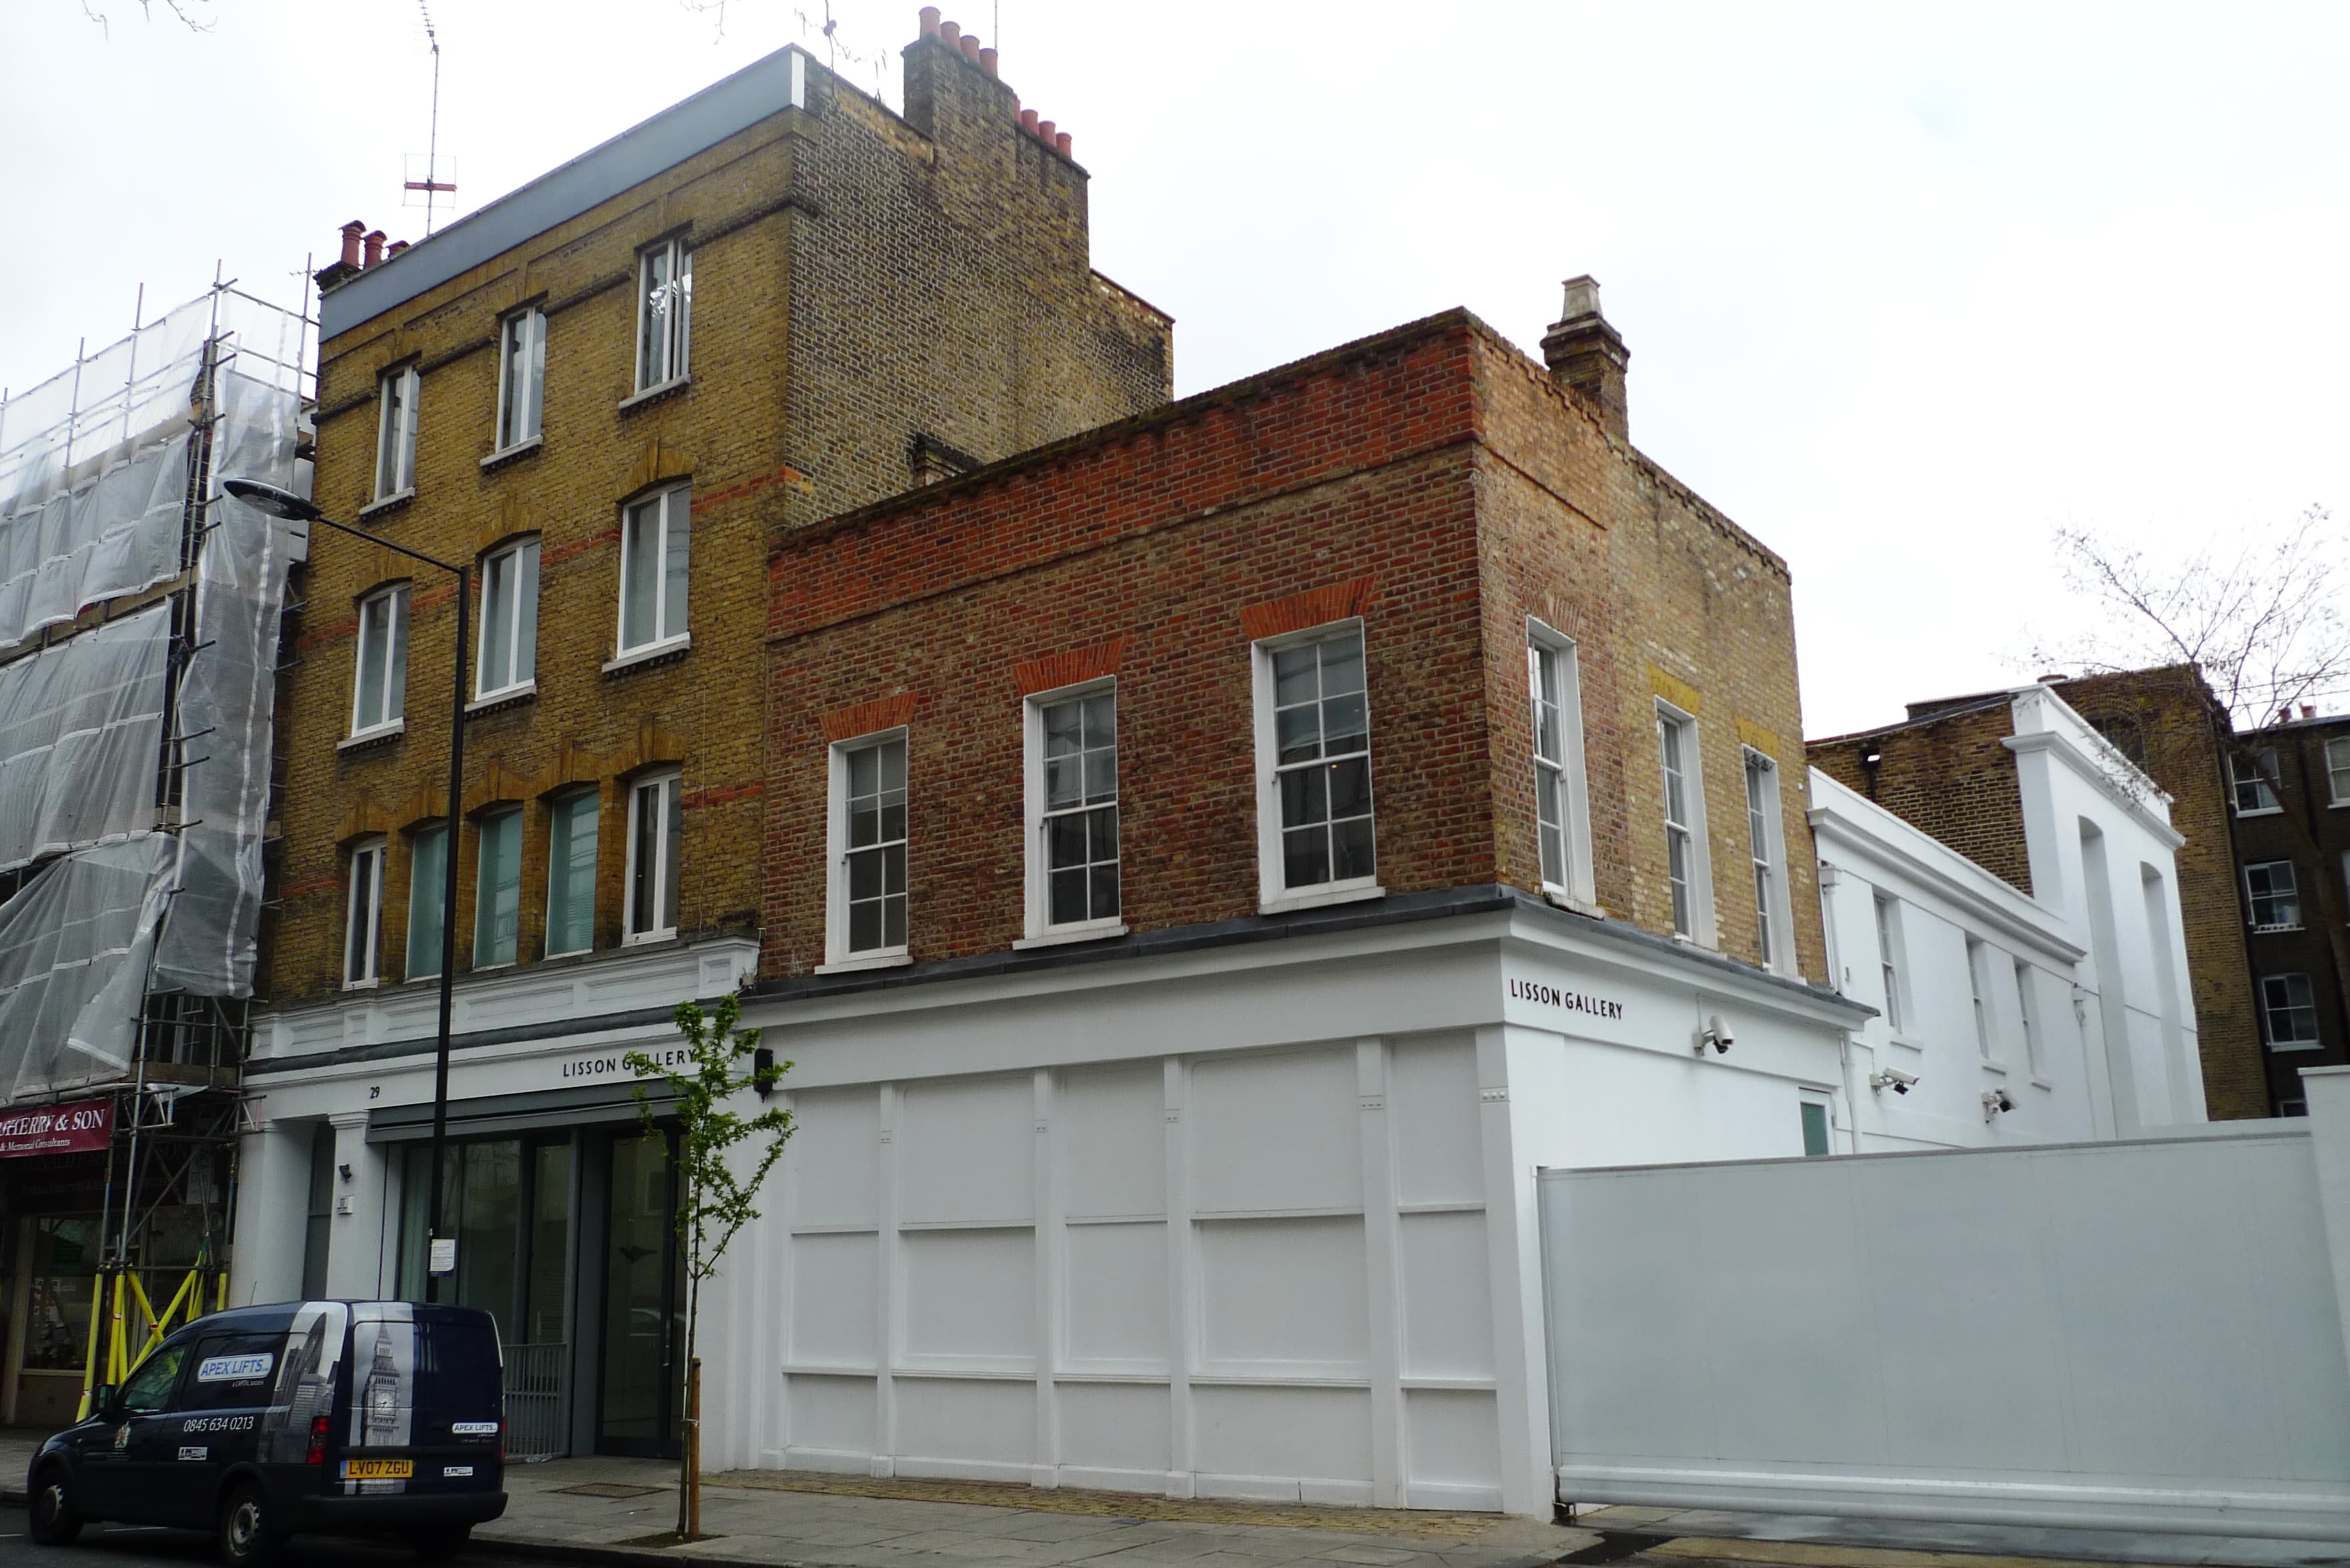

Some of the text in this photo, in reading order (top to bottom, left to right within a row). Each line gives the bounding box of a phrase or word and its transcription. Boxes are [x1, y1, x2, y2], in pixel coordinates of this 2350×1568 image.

[1511, 978, 1622, 1020] LISSON GALLERY
[563, 1048, 697, 1077] LISSON GLLERY
[370, 1086, 380, 1099] 29
[55, 1114, 69, 1132] &
[72, 1109, 105, 1130] SON
[201, 1359, 264, 1376] APEX LIFTS
[183, 1416, 254, 1432] 0845 634 0213
[349, 1461, 382, 1475] LV07
